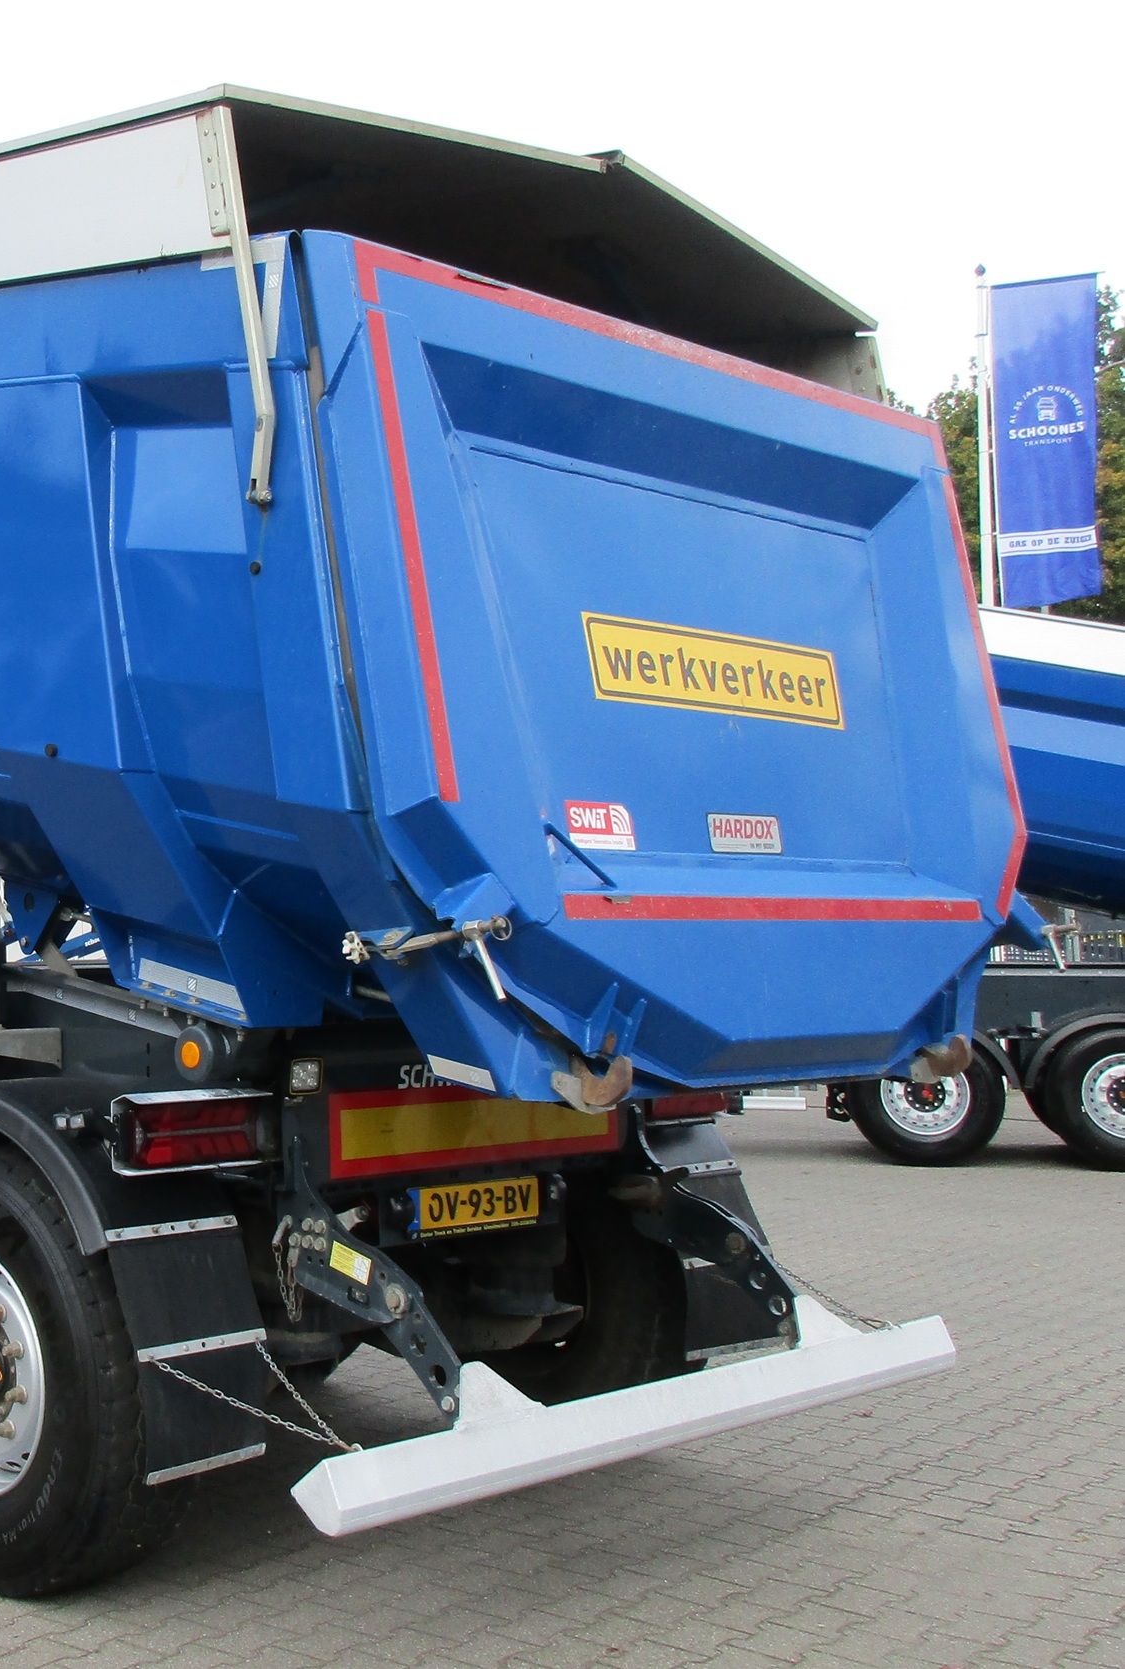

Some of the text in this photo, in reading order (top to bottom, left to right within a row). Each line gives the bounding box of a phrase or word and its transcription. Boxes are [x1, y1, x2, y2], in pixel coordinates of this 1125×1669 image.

[1008, 421, 1085, 440] SCHOONES
[1024, 437, 1073, 447] TRANSPORT
[1009, 540, 1026, 548] GAS
[1031, 539, 1043, 547] OP
[602, 645, 826, 707] werkverkeer
[712, 818, 773, 839] HARDOX
[398, 1065, 448, 1089] SCH
[428, 1184, 532, 1223] OV-93-BV
